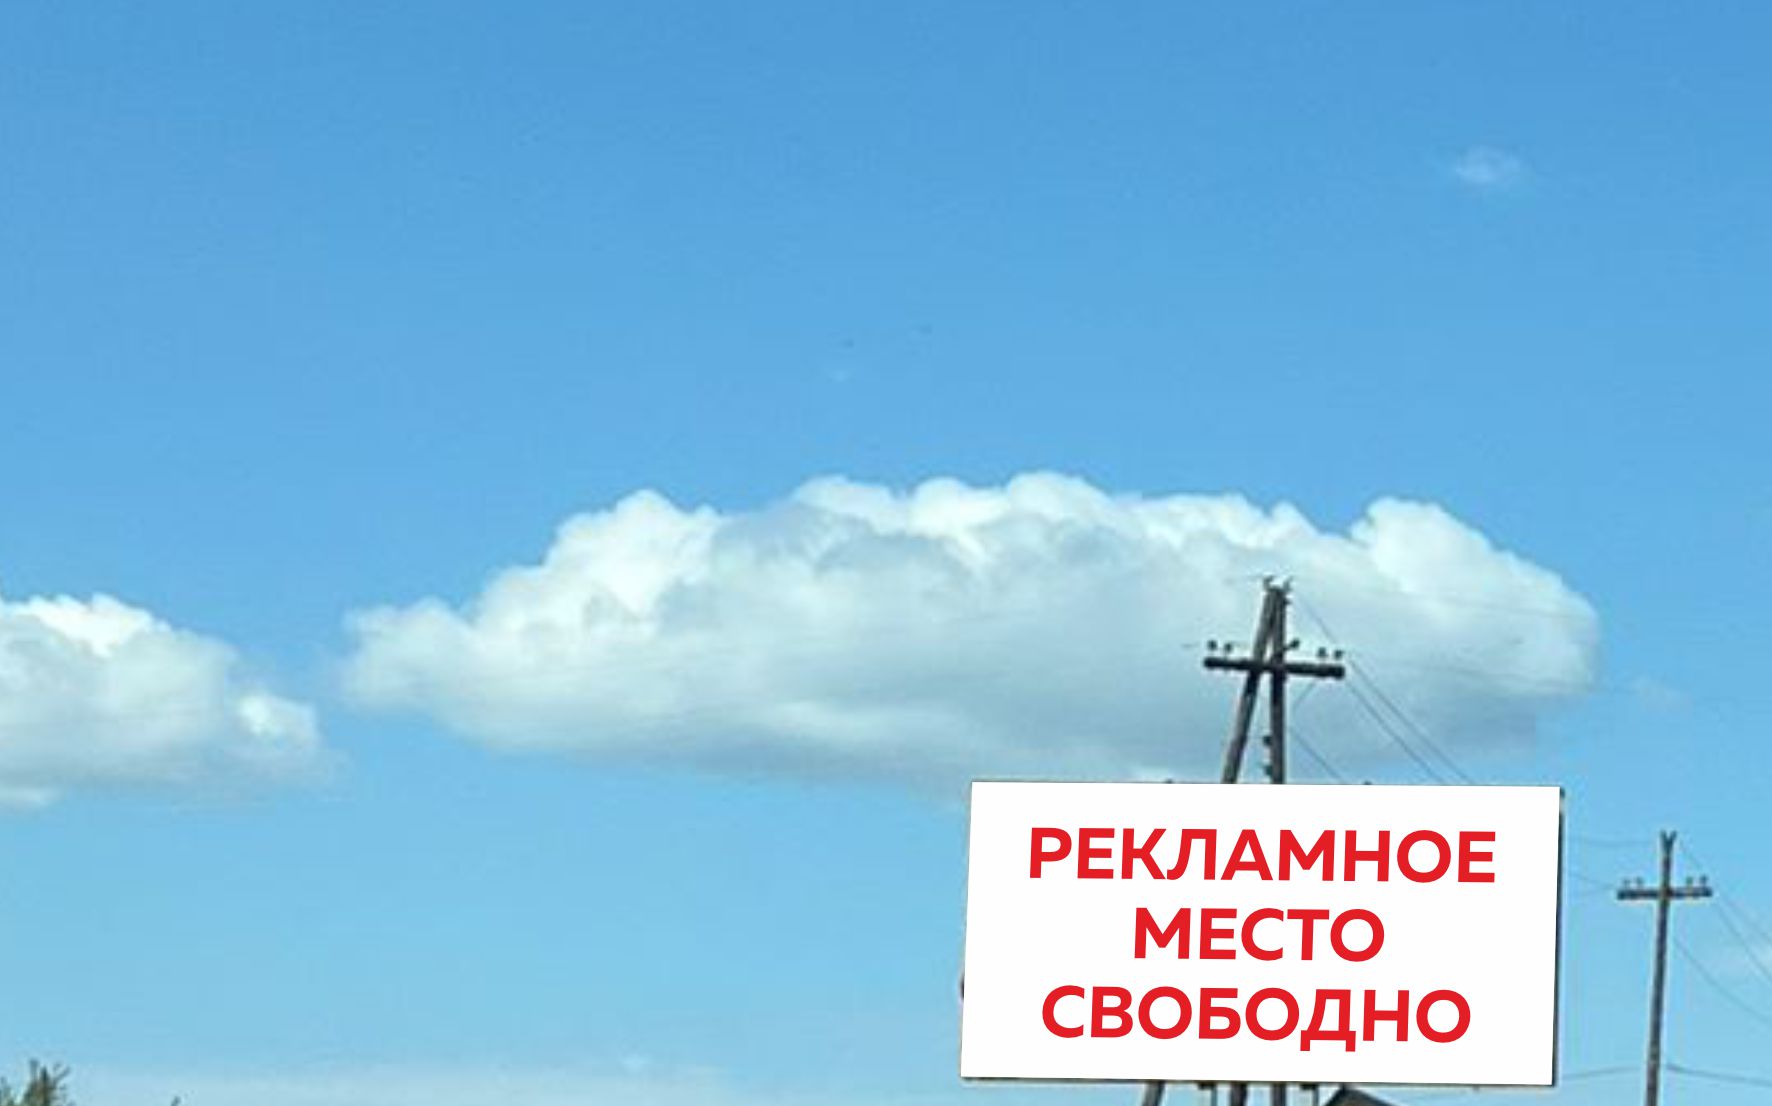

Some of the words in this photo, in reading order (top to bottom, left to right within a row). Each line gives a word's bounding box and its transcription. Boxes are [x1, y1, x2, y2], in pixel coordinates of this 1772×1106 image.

[1029, 827, 1496, 884] РЕКЛАМНОЕ
[1133, 907, 1385, 963] МЕСТО
[1042, 984, 1471, 1053] СВОБОДНО
